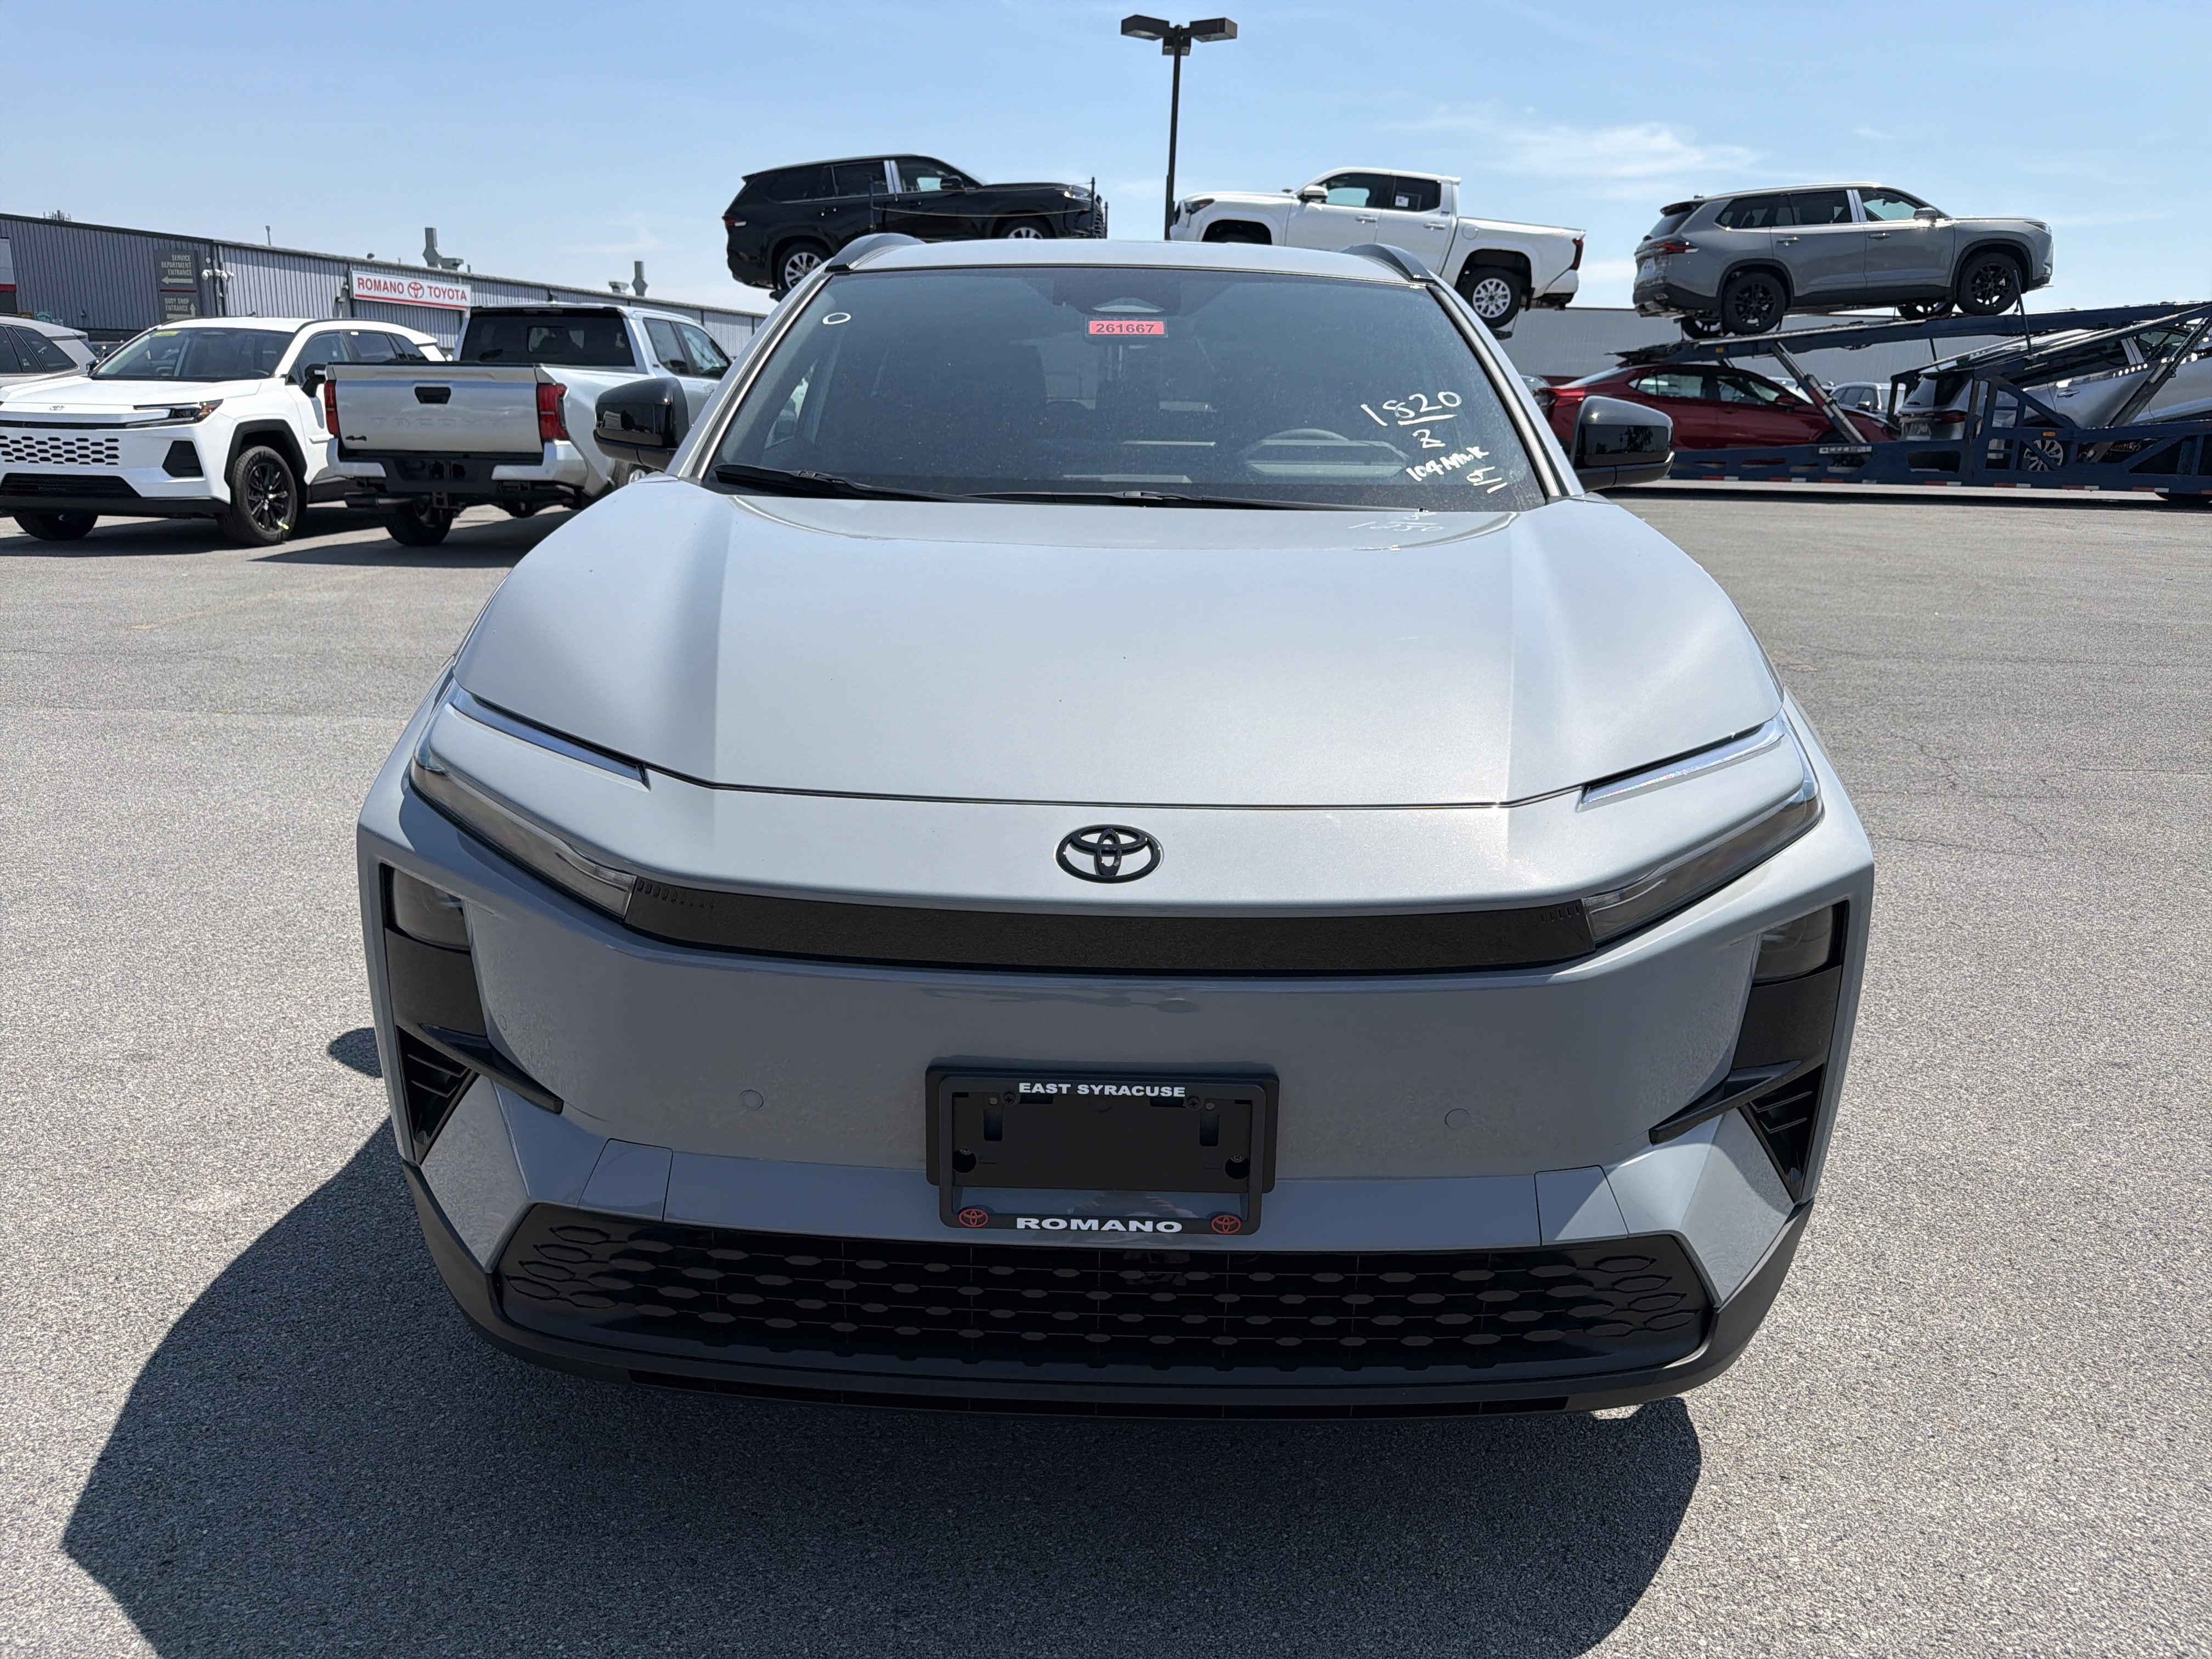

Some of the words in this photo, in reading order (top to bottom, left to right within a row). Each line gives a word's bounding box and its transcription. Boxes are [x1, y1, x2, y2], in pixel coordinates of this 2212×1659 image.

[357, 277, 405, 295] ROMANO
[427, 285, 467, 301] TOYOTA
[1096, 323, 1155, 334] 261667
[1019, 1082, 1071, 1094] EAST
[1077, 1084, 1186, 1097] SYRACUSE
[1017, 1217, 1182, 1233] ROMANO
